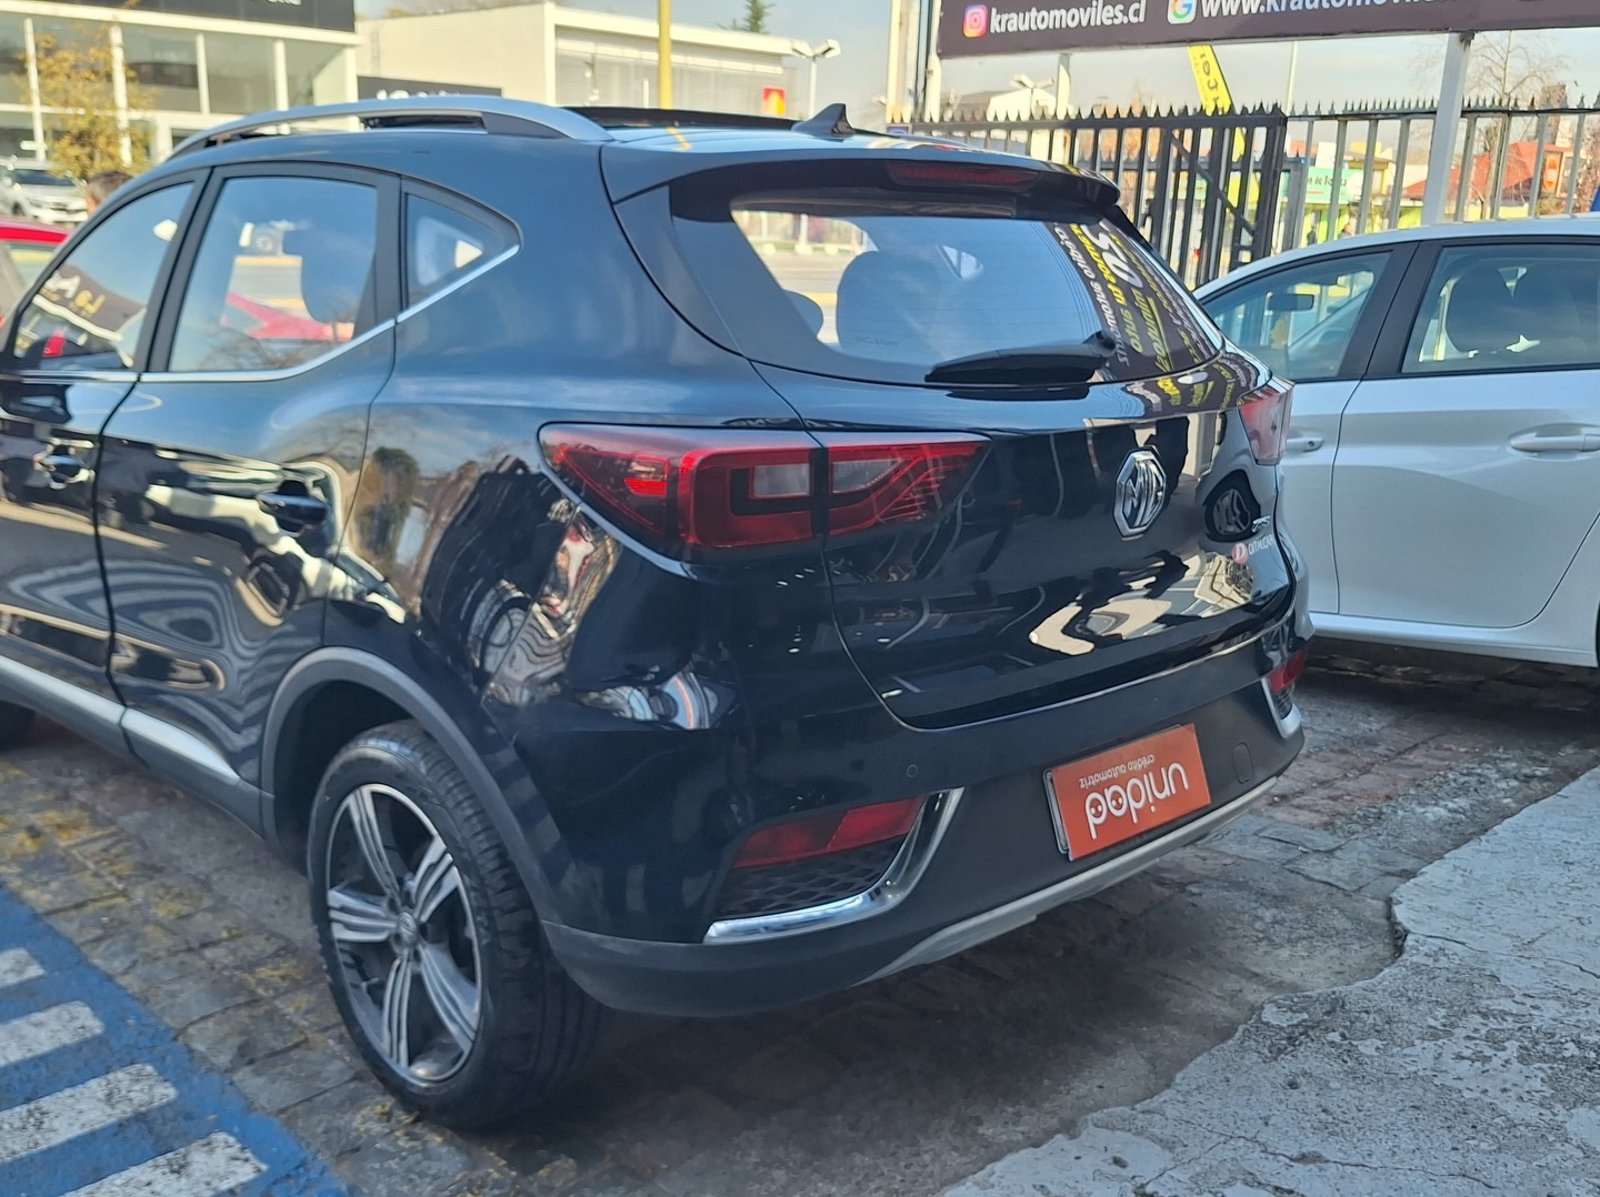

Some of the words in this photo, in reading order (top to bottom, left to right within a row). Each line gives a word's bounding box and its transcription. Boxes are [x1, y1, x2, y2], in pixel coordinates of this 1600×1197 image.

[990, 1, 1146, 33] krautomoviles.cl
[1200, 0, 1434, 18] www.krau
[1117, 456, 1165, 530] MG
[1078, 764, 1126, 789] automotriz
[1127, 754, 1156, 774] crédito
[1085, 762, 1189, 840] unidad
